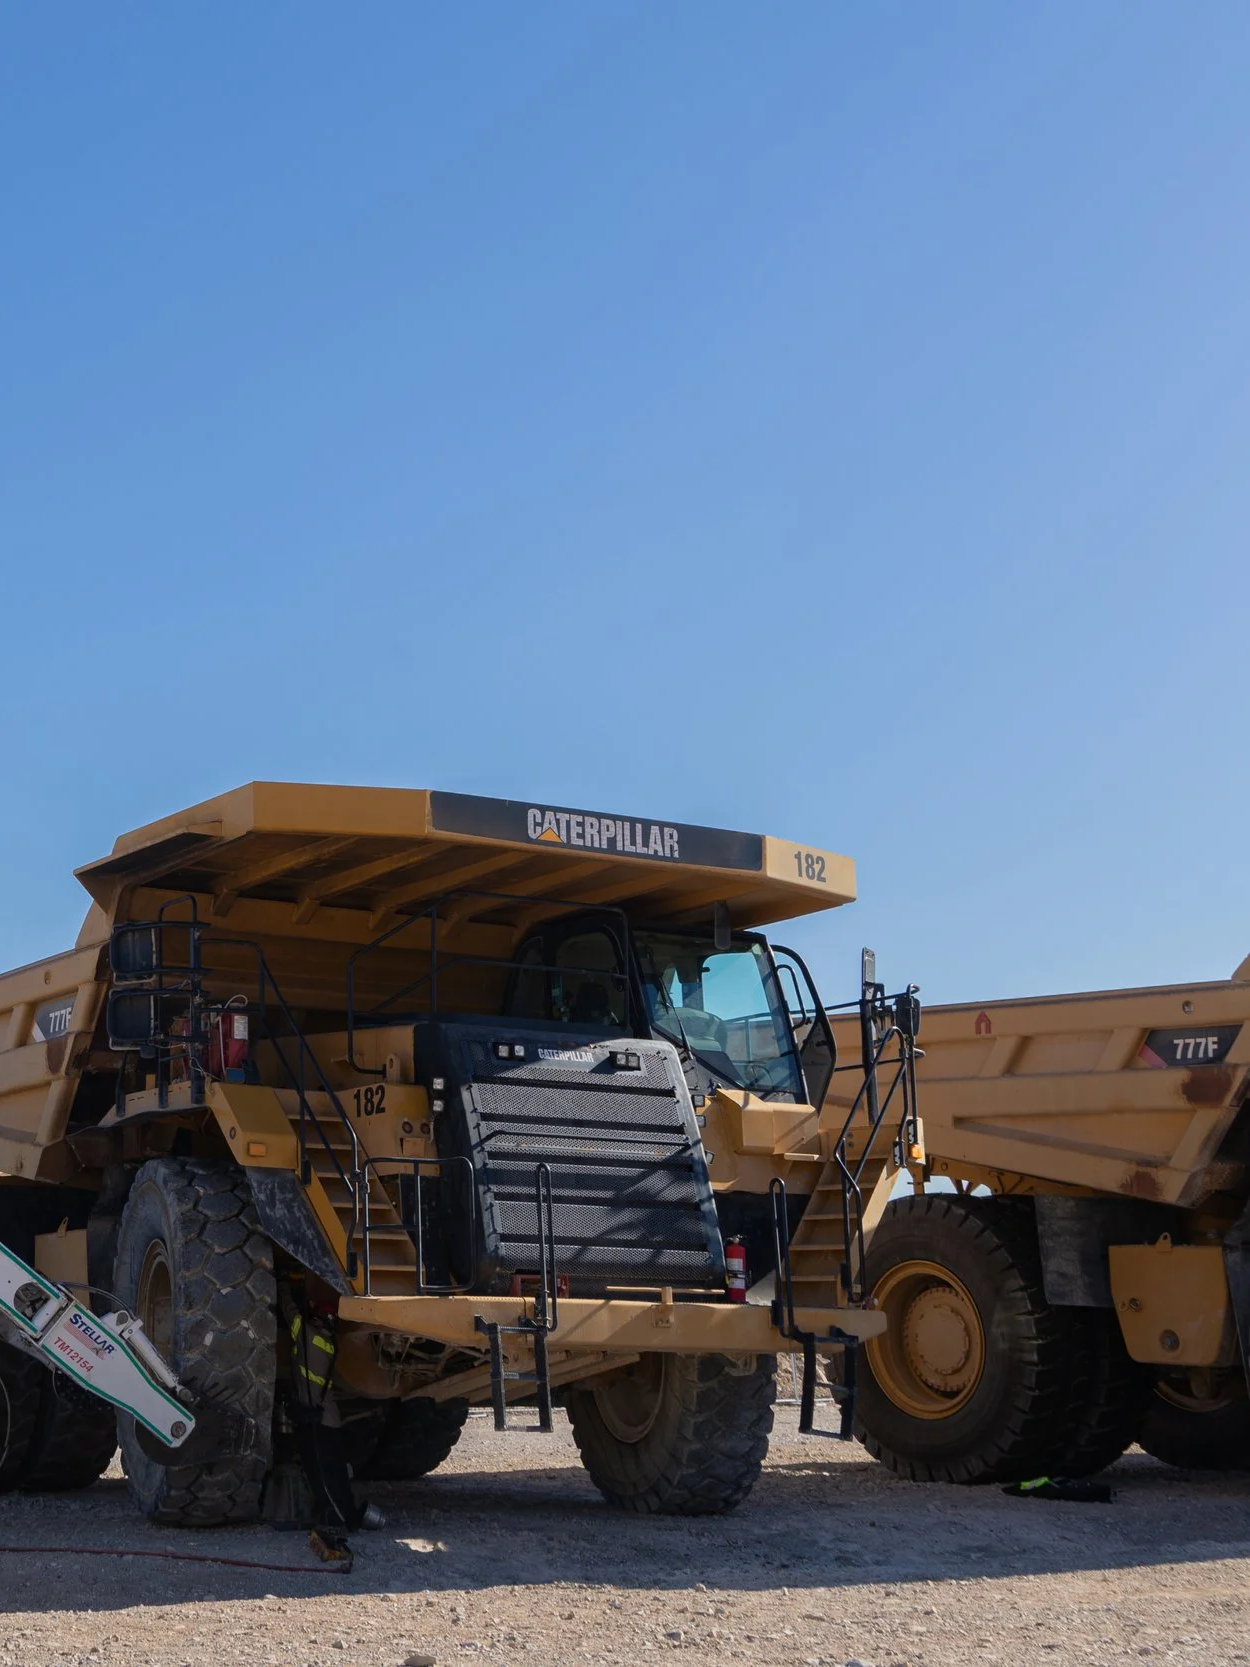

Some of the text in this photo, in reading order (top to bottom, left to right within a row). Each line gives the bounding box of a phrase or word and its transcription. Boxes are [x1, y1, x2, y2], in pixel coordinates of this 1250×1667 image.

[527, 808, 680, 858] CATERPILLAR
[794, 850, 827, 883] 182
[49, 1007, 72, 1033] 777F
[537, 1047, 594, 1063] CATERPILLAR
[1173, 1036, 1218, 1060] 777F
[353, 1084, 386, 1118] 182
[69, 1313, 115, 1355] STELLAR
[53, 1336, 94, 1373] TM12154
